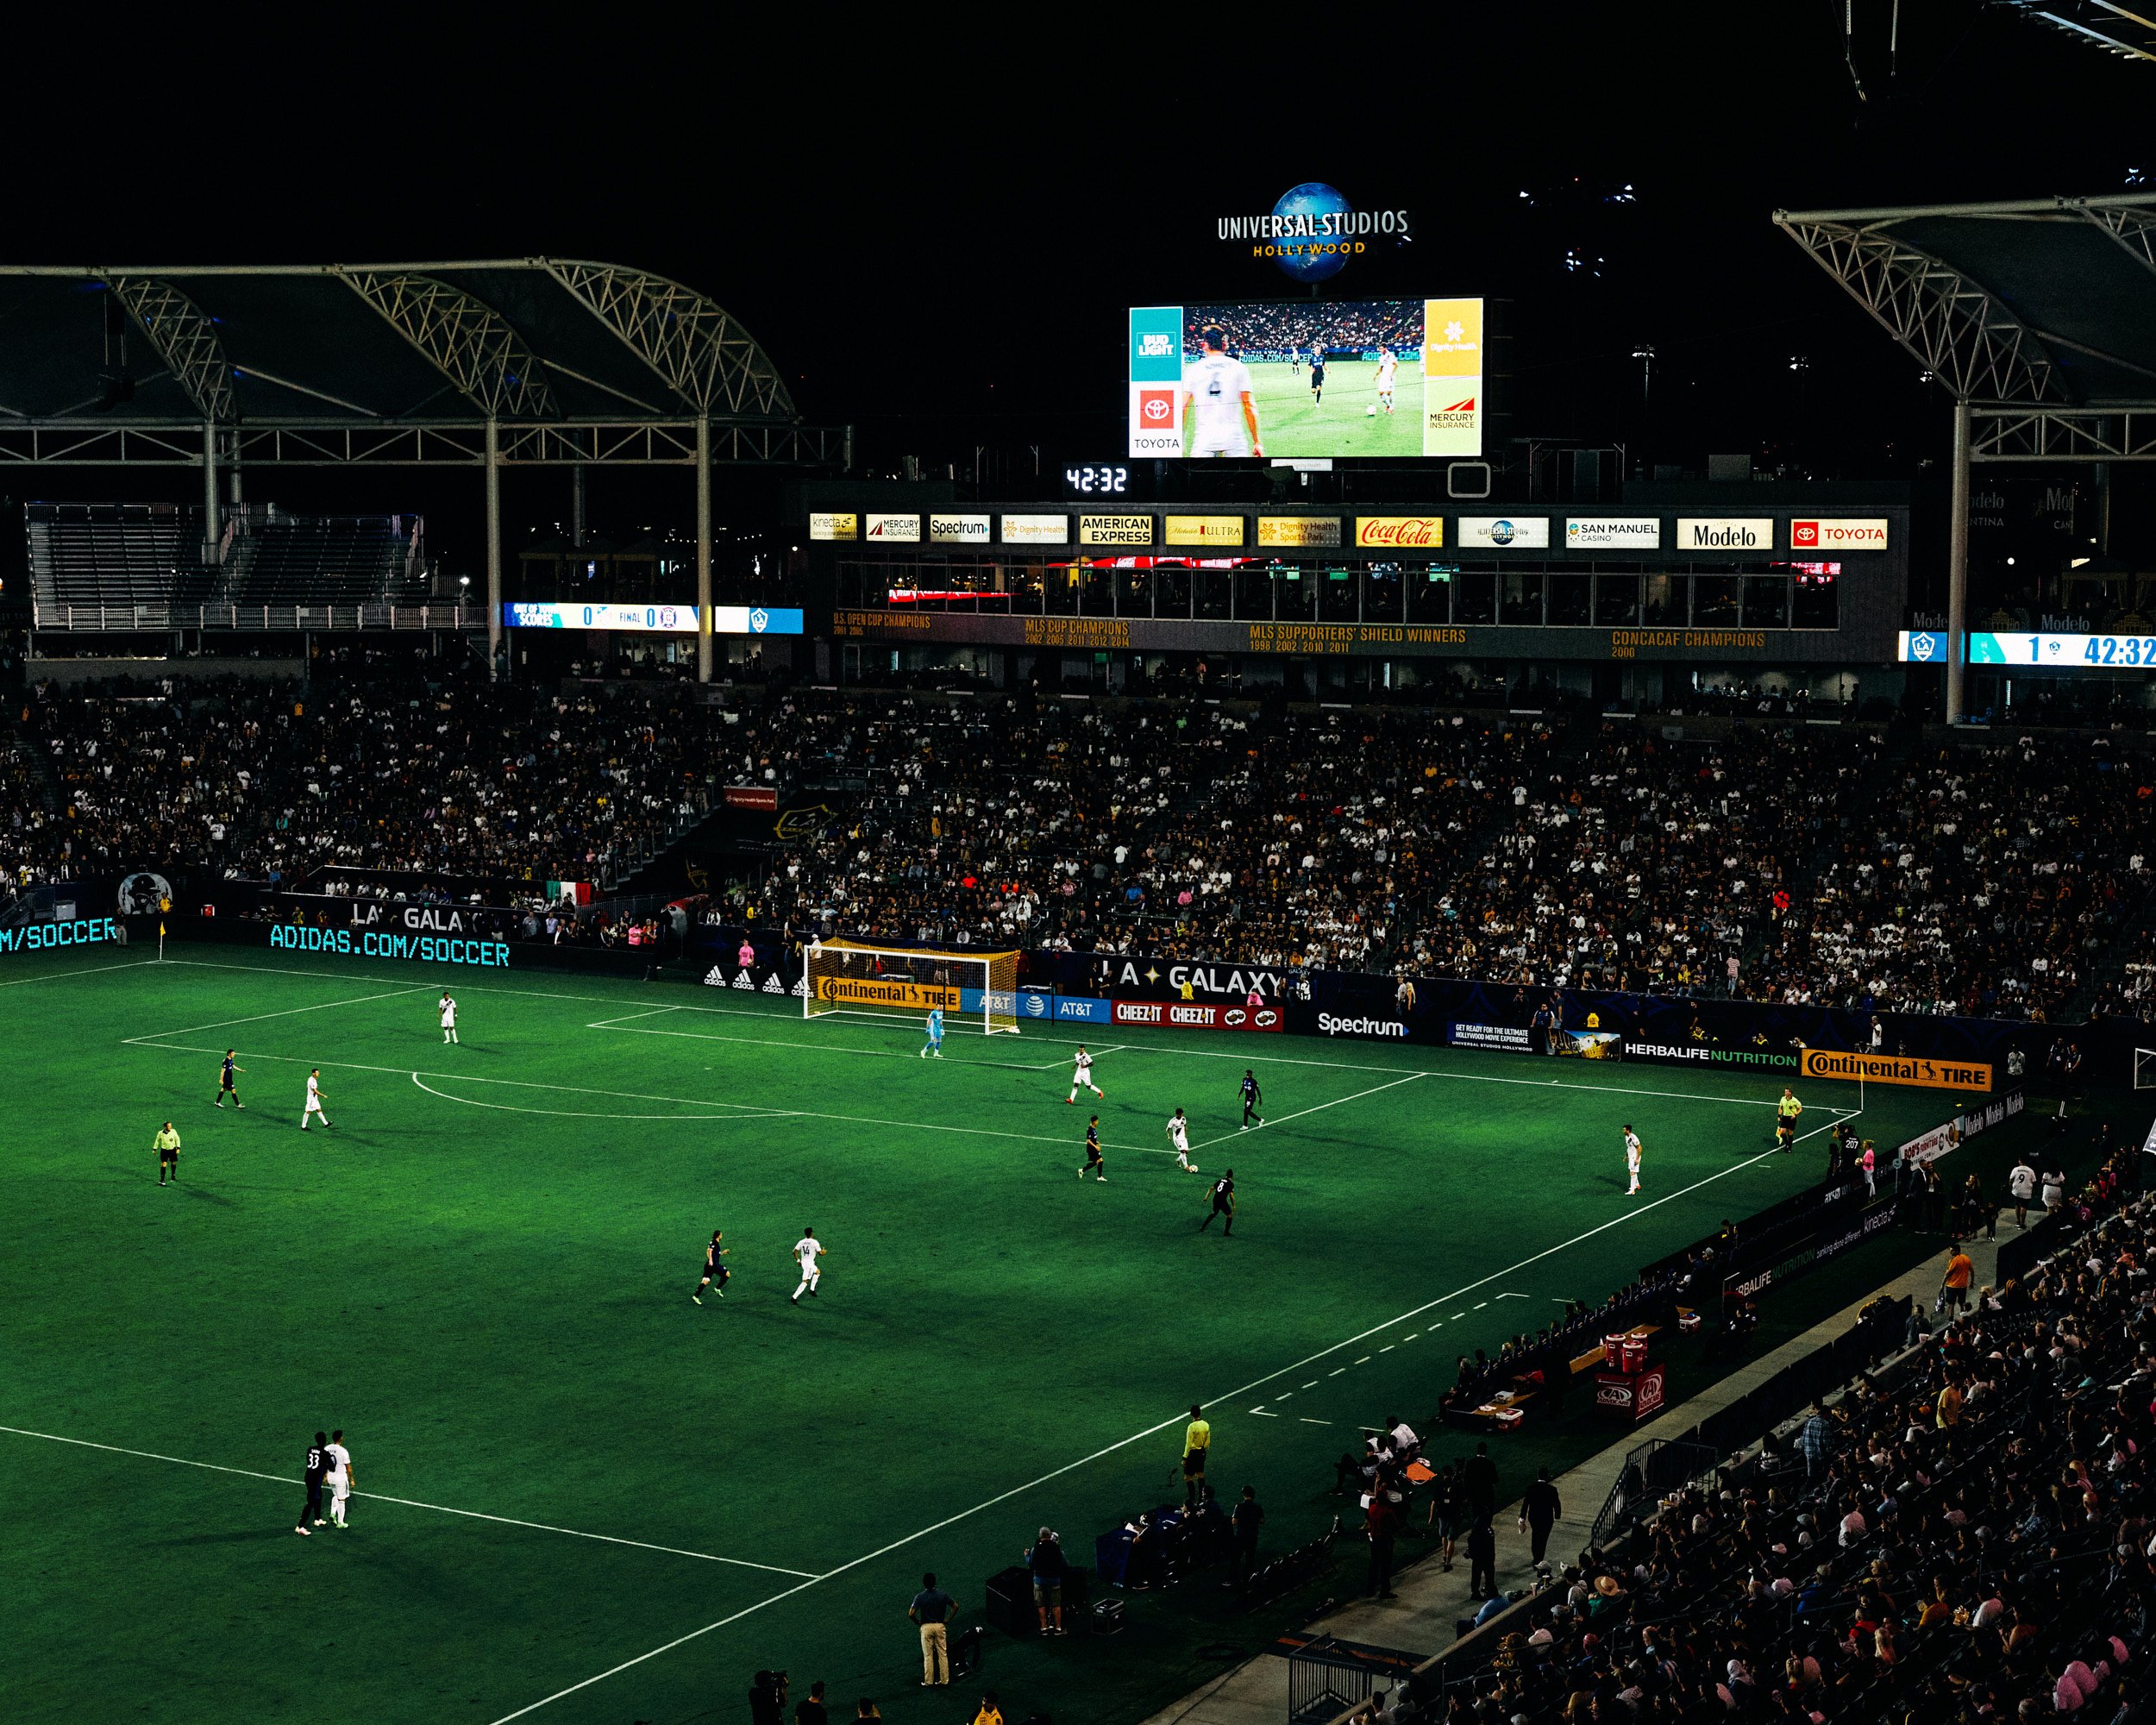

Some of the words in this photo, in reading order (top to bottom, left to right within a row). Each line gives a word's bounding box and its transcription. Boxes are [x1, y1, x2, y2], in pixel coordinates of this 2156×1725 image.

[1218, 213, 1319, 240] UNIVERSAL
[1321, 210, 1409, 236] STUDIOS
[1253, 242, 1365, 257] HOLLYWOOD
[1143, 334, 1169, 346] BUD
[1138, 344, 1175, 356] LIGHT
[1430, 413, 1475, 422] MERCURY
[1134, 438, 1180, 448] TOYOTA
[1066, 467, 1127, 492] 42:32
[1969, 492, 2004, 509] odelo
[812, 516, 841, 528] kinecta
[883, 519, 919, 529] MERCURY
[931, 519, 985, 537] Spectrum
[1019, 524, 1043, 535] Dignity
[1044, 524, 1065, 533] Health
[1081, 518, 1150, 530] AMERICAN
[1280, 522, 1309, 533] Dignity
[1310, 522, 1337, 530] Health
[1581, 524, 1608, 535] SAN
[1608, 524, 1658, 535] MANUEL
[1970, 518, 2004, 527] NTINA
[1091, 530, 1151, 543] EXPRESS
[1206, 526, 1241, 536] ULTRA
[1280, 532, 1306, 543] Sports
[1307, 532, 1325, 541] Park
[1362, 519, 1436, 545] Coca-Cola
[1693, 524, 1756, 547] Modelo
[1824, 529, 1885, 540] TOYOTA
[519, 613, 554, 627] SCORES
[583, 606, 592, 626] 0
[619, 612, 641, 623] FINAL
[646, 608, 655, 628] 0
[833, 612, 846, 624] U.S.
[847, 613, 866, 626] OPEN
[868, 613, 881, 626] CUP
[884, 614, 931, 629] CHAMPIONS
[1913, 611, 1949, 628] Mode
[2041, 614, 2090, 631] Modelo
[1025, 619, 1046, 633] MLS
[1048, 620, 1068, 634] CUP
[1069, 620, 1129, 635] CHAMPIONS
[1250, 625, 1275, 639] MLS
[1278, 626, 1357, 641] SUPPORTERS'
[1360, 627, 1403, 642] SHIELD
[1407, 629, 1466, 643] WINNERS
[1025, 634, 1043, 644] 2002
[1046, 634, 1064, 645] 2005
[1069, 635, 1085, 646] 2011
[1089, 636, 1107, 647] 2012
[1112, 636, 1130, 647] 2014
[1612, 631, 1681, 647] CONCACAF
[1684, 632, 1765, 647] CHAMPIONS
[1916, 642, 1931, 651] LA
[1250, 641, 1271, 651] 1998
[1275, 641, 1297, 652] 2002
[1302, 642, 1324, 653] 2010
[1329, 642, 1350, 653] 2011
[1612, 647, 1635, 658] 2000
[2028, 636, 2040, 662] 1
[2084, 637, 2156, 666] 42:32
[353, 903, 381, 925] LA
[270, 924, 510, 967] ADIDAS.COM/SOCCER
[704, 977, 726, 988] adidas
[732, 981, 755, 991] adidas
[822, 976, 906, 1001] Continental
[1169, 965, 1282, 997] GALAXY
[762, 984, 785, 994] adidas
[1060, 1001, 1093, 1017] AT&T
[1116, 1003, 1163, 1022] CHEEZ-IT
[1169, 1006, 1216, 1025] CHEEZ-IT
[1318, 1012, 1404, 1037] Spectrum
[1466, 1024, 1483, 1033] READY
[1482, 1026, 1494, 1034] FOR
[1494, 1026, 1504, 1035] THE
[1504, 1027, 1529, 1037] ULTIMATE
[1455, 1031, 1485, 1040] HOLLYWOOD
[1484, 1033, 1501, 1042] MOVIE
[1501, 1035, 1529, 1044] EXPERIENCE
[1625, 1043, 1709, 1060] HERBALIFE
[1710, 1050, 1797, 1067] NUTRITION
[1807, 1051, 1919, 1079] Continental
[1940, 1067, 1986, 1085] TIRE
[1965, 1111, 1984, 1138] Modelo
[1986, 1101, 2004, 1127] Modelo
[2006, 1091, 2024, 1117] Modelo
[1845, 1139, 1858, 1150] 207
[1904, 1142, 1920, 1160] BOB'S
[2018, 1174, 2025, 1183] 9
[1217, 1182, 1225, 1192] 8
[1864, 1209, 1888, 1234] kinecta
[802, 1245, 810, 1257] 14
[1816, 1243, 1833, 1259] banking
[1833, 1239, 1844, 1251] done
[1844, 1230, 1861, 1245] different
[1737, 1270, 1772, 1297] RBALIFE
[1771, 1248, 1815, 1281] NUTRITION
[1597, 1397, 1632, 1407] ADVOCARE
[307, 1452, 320, 1470] 33
